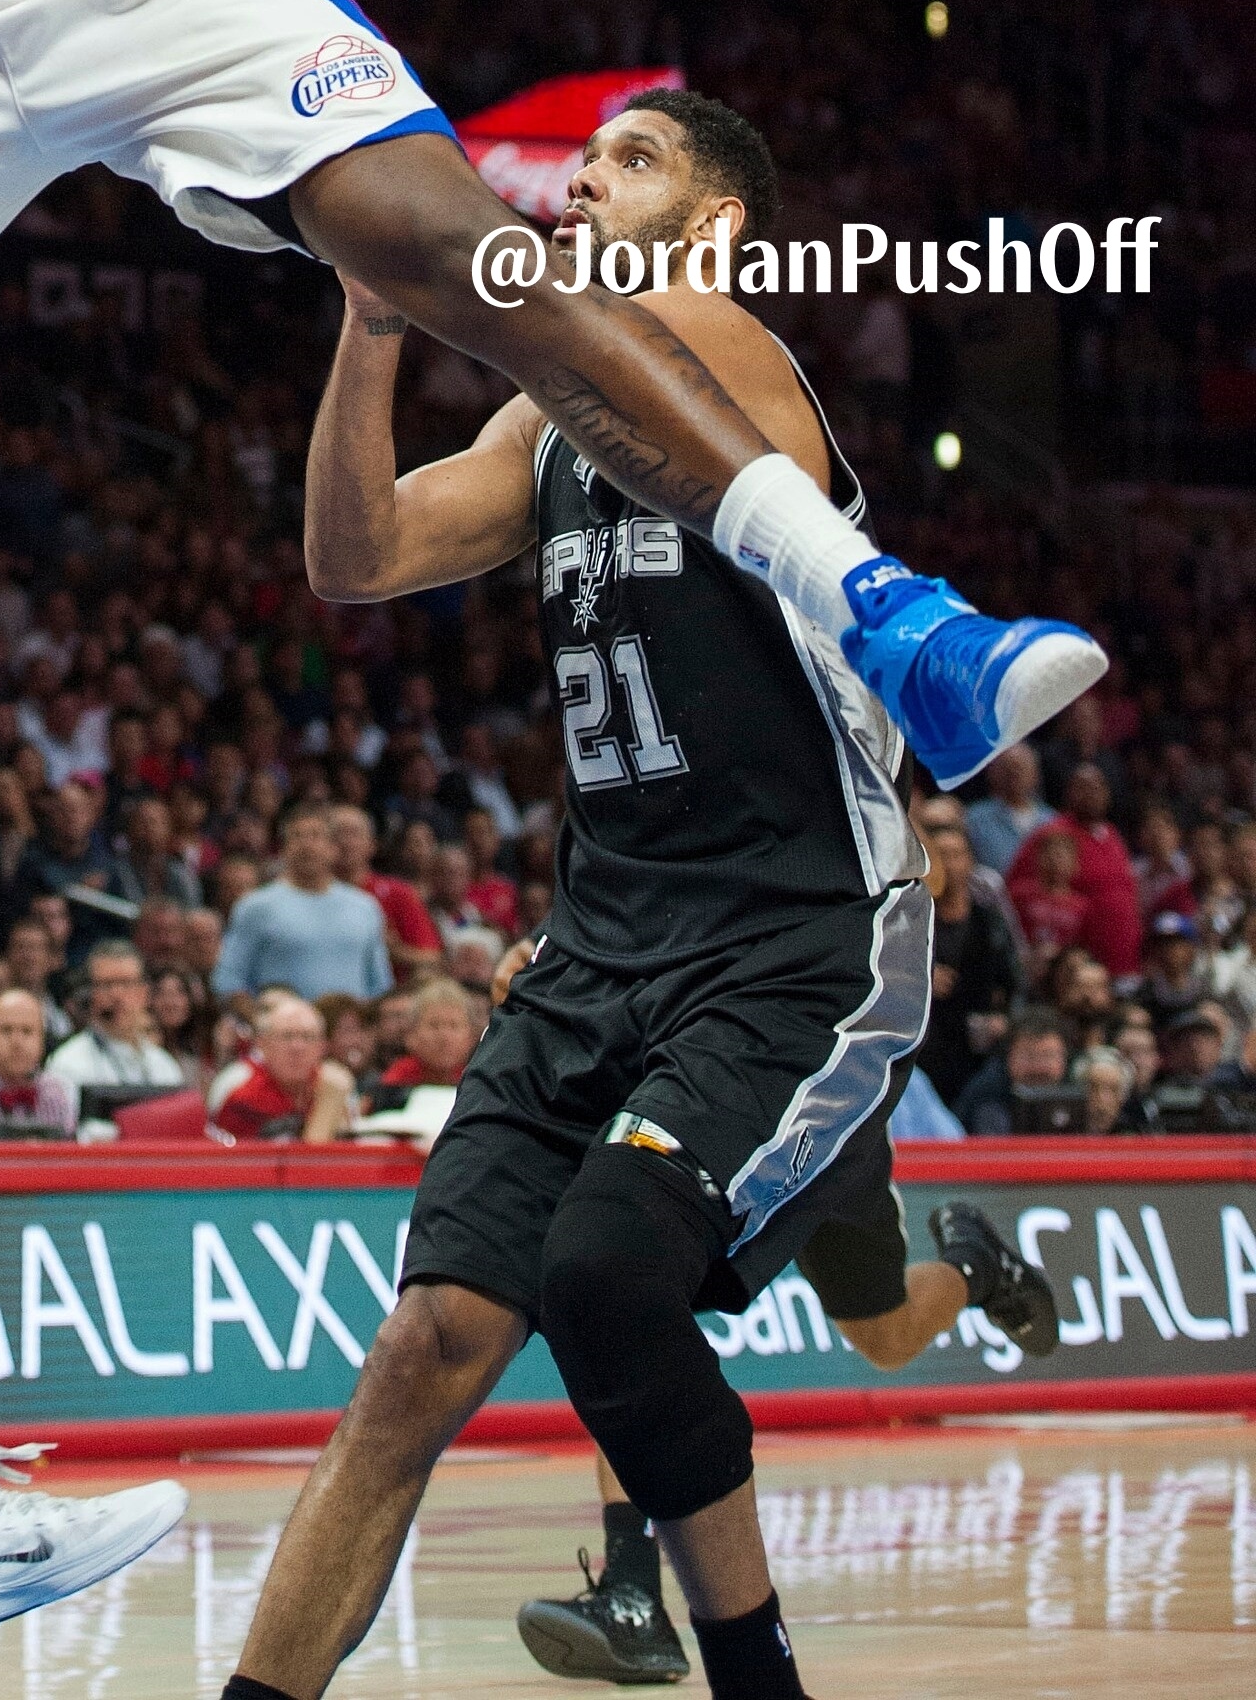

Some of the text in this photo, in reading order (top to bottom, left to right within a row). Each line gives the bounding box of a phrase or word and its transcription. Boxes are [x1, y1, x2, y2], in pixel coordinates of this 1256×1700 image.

[291, 63, 389, 118] CLIPPERS
[321, 55, 382, 74] LOS ANGELES
[554, 634, 690, 792] 21
